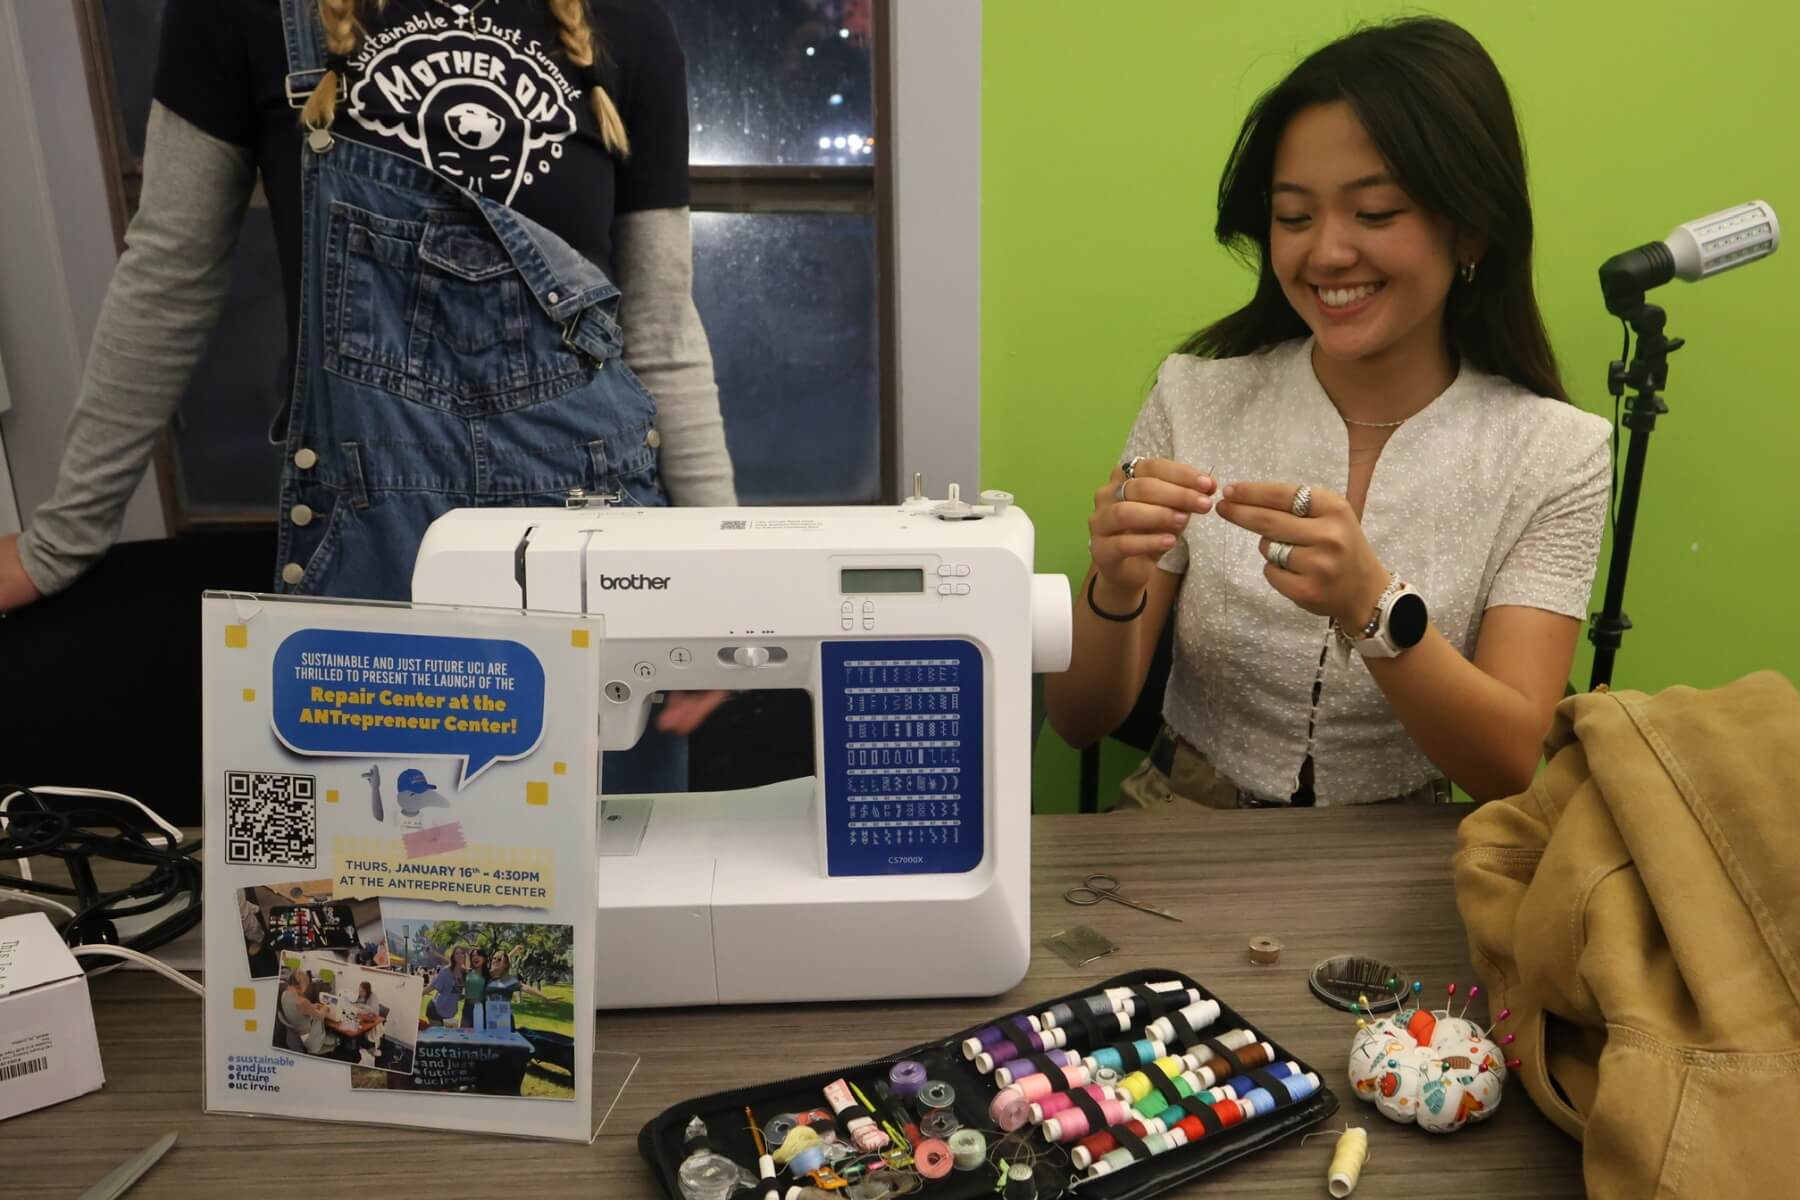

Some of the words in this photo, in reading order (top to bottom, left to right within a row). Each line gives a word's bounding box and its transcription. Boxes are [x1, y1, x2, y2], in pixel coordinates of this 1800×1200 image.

[346, 11, 448, 71] Sustainable
[478, 17, 522, 45] Just
[524, 40, 582, 101] Summit
[374, 51, 507, 114] MOTHER
[600, 574, 671, 590] brother
[301, 652, 370, 669] SUSTAINABLE
[373, 656, 394, 670] AND
[397, 658, 422, 671] JUST
[425, 659, 464, 673] FUTURE
[467, 661, 484, 674] UCI
[488, 662, 508, 676] ARE
[294, 666, 343, 681] THRILLED
[346, 669, 359, 682] TO
[362, 670, 408, 685] PRESENT
[411, 672, 431, 686] THE
[434, 674, 475, 688] LAUNCH
[479, 676, 491, 689] OF
[495, 677, 514, 690] THE
[311, 686, 376, 706] Repair
[379, 690, 446, 709] Center
[448, 692, 469, 712] at
[473, 694, 506, 712] the
[300, 708, 440, 731] ANTrepreneur
[443, 716, 518, 734] Center!
[346, 860, 391, 874] THURS,
[395, 863, 456, 877] JANUARY
[459, 867, 480, 878] 16th
[493, 870, 540, 882] 4:30PM
[888, 856, 923, 864] CS7000X
[339, 875, 357, 885] AT
[361, 876, 385, 888] THE
[388, 878, 491, 894] ANTREPRENEUR
[495, 884, 546, 898] CENTER
[235, 1055, 295, 1067] sustainable
[235, 1064, 256, 1073] and
[257, 1064, 277, 1074] just
[235, 1082, 249, 1090] uc
[250, 1082, 280, 1092] irvine
[236, 1072, 270, 1082] future
